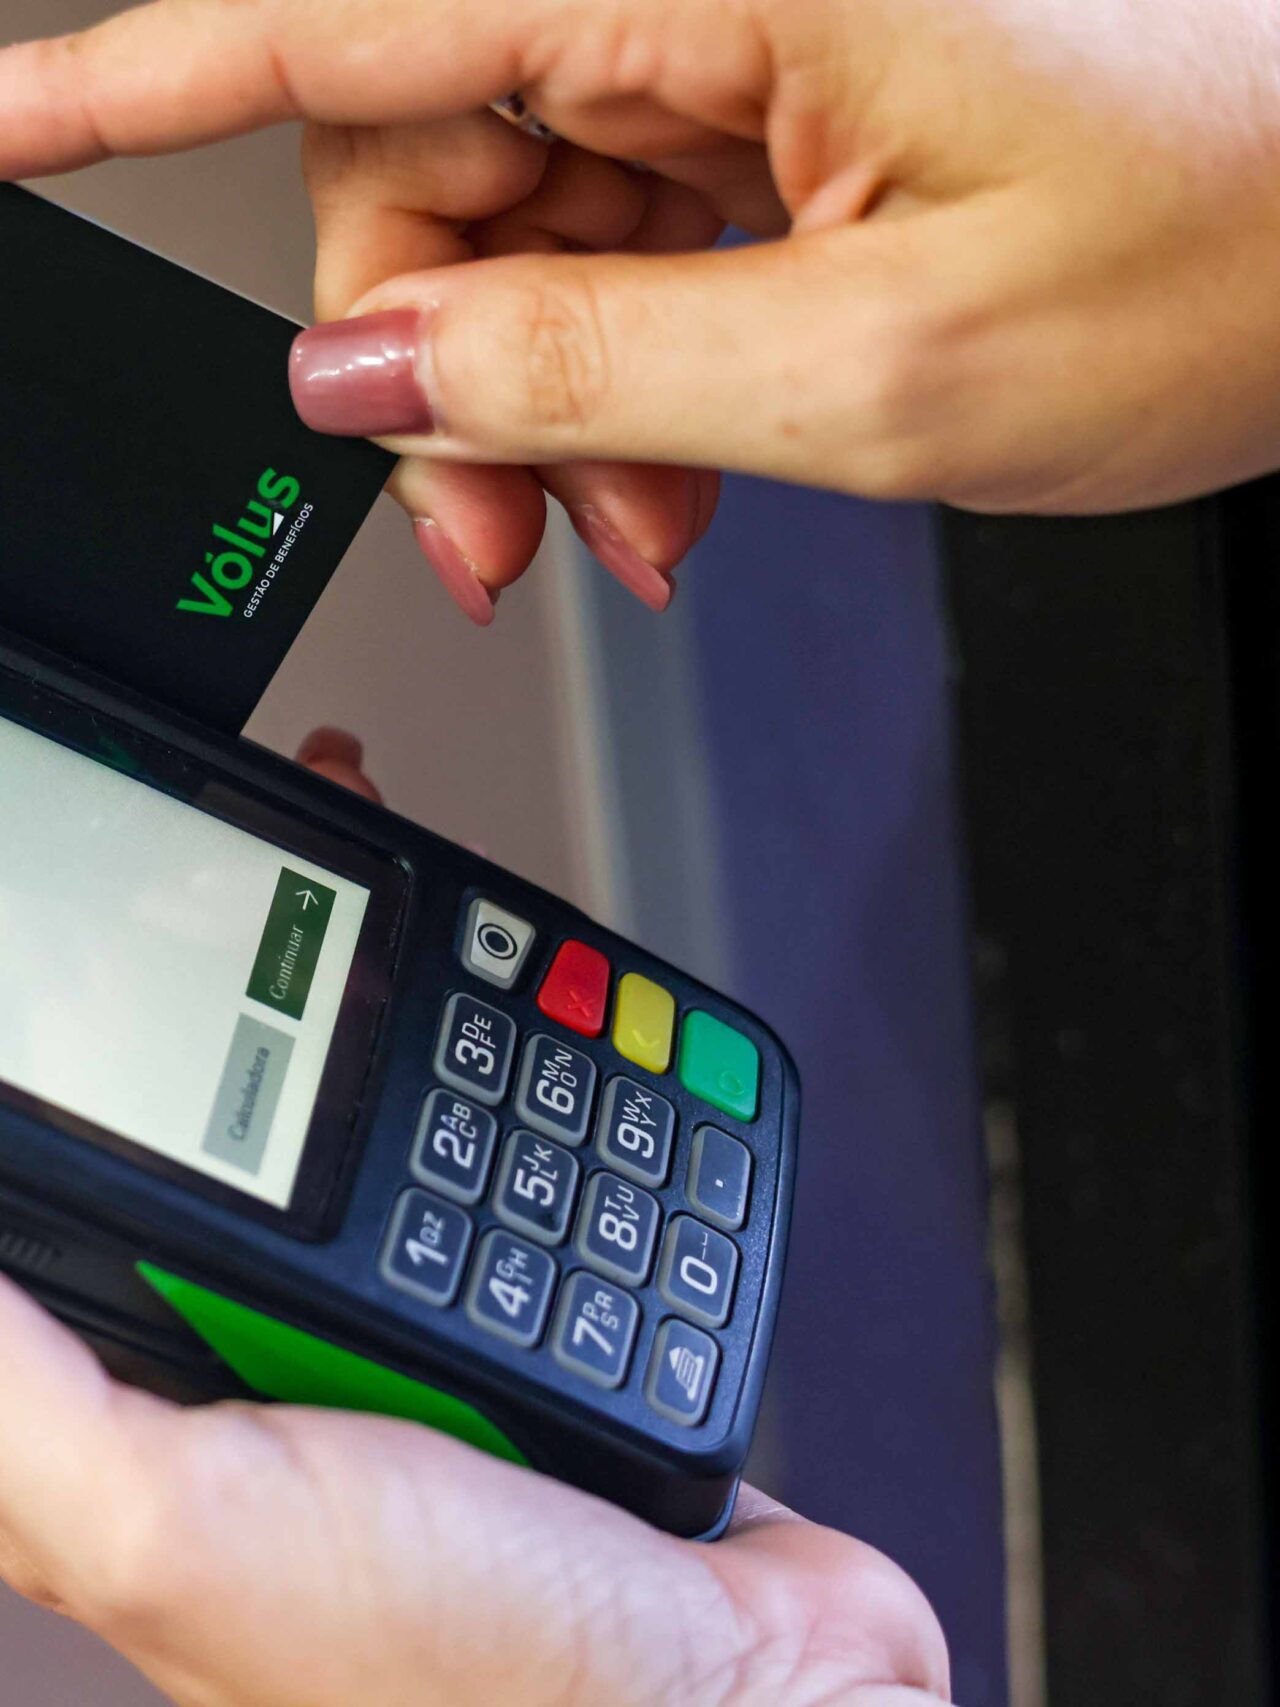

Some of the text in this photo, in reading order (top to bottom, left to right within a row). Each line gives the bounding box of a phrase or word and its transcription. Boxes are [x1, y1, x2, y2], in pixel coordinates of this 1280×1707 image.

[176, 467, 301, 617] Vólus
[243, 502, 314, 618] GESTÃO DE BENEFÍCIOS
[268, 923, 305, 1001] Continuar
[454, 1038, 495, 1076] 3
[227, 1046, 271, 1142] Calculadora
[536, 1079, 575, 1115] 6
[432, 1128, 475, 1169] 2
[616, 1123, 655, 1160] 9
[513, 1168, 555, 1207] 5
[405, 1237, 449, 1266] 1
[598, 1212, 638, 1252] 8
[680, 1255, 718, 1295] 0
[488, 1276, 532, 1319] 4
[571, 1315, 615, 1357] 7
